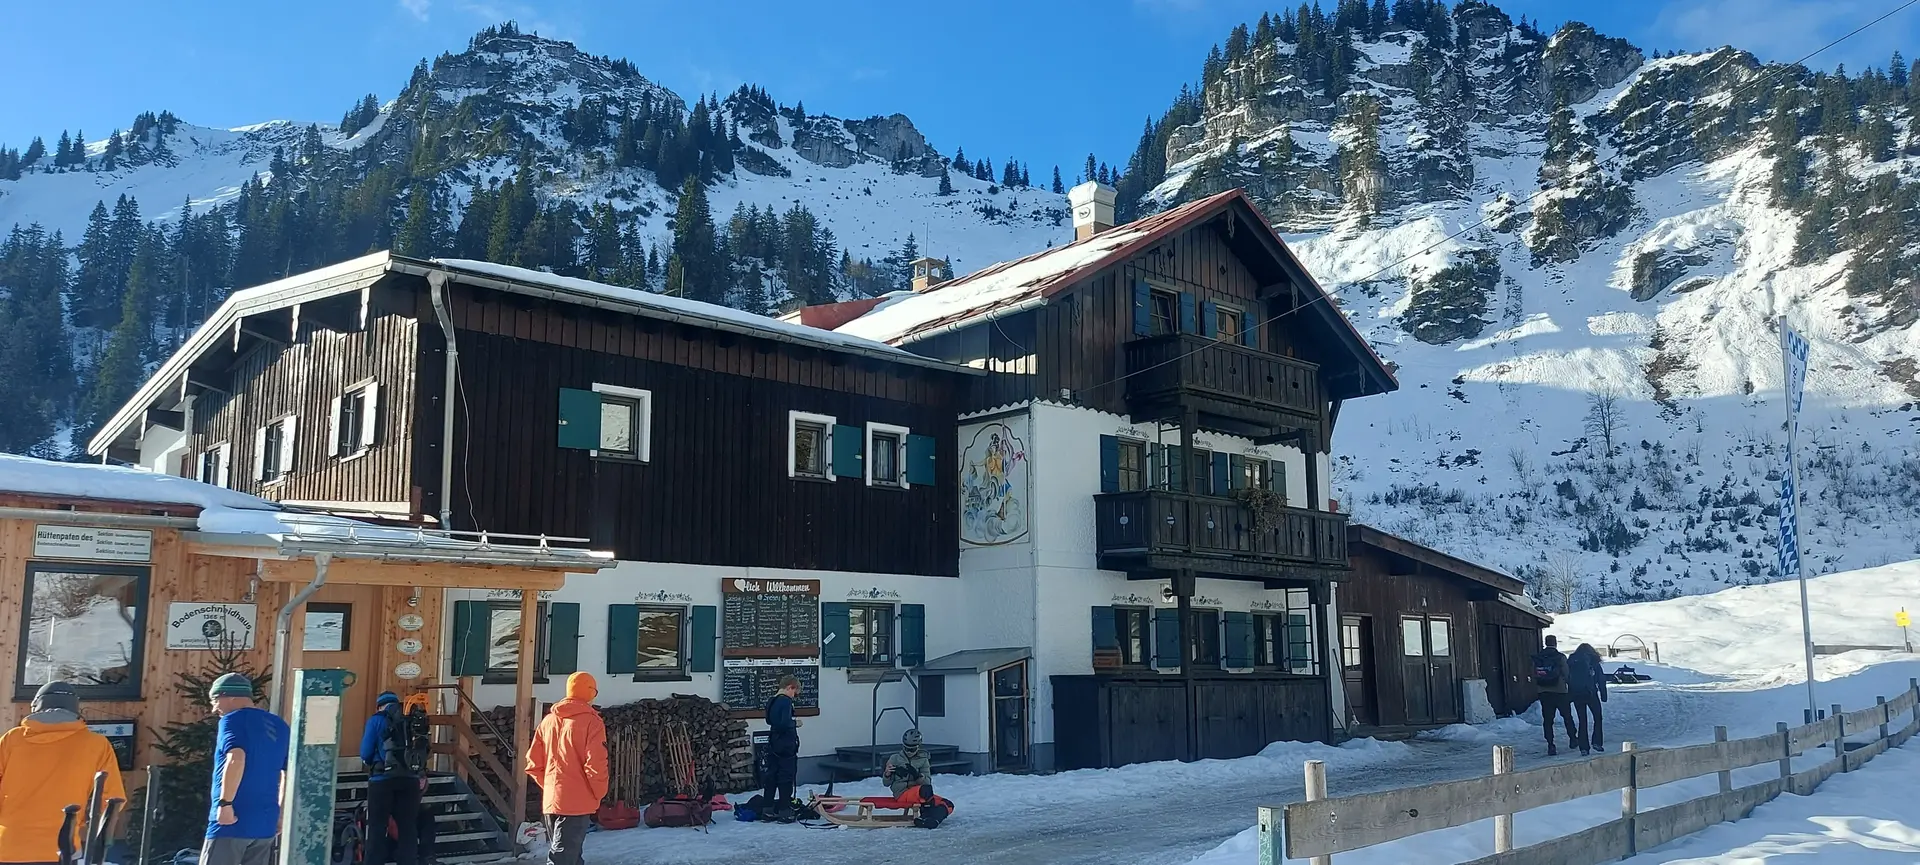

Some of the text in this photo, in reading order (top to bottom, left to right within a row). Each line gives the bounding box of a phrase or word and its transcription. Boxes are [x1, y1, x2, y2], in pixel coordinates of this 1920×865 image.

[37, 531, 94, 541] Hüttenpaten des
[766, 581, 811, 592] Willkommen
[171, 604, 252, 630] Bodenschneidhaus
